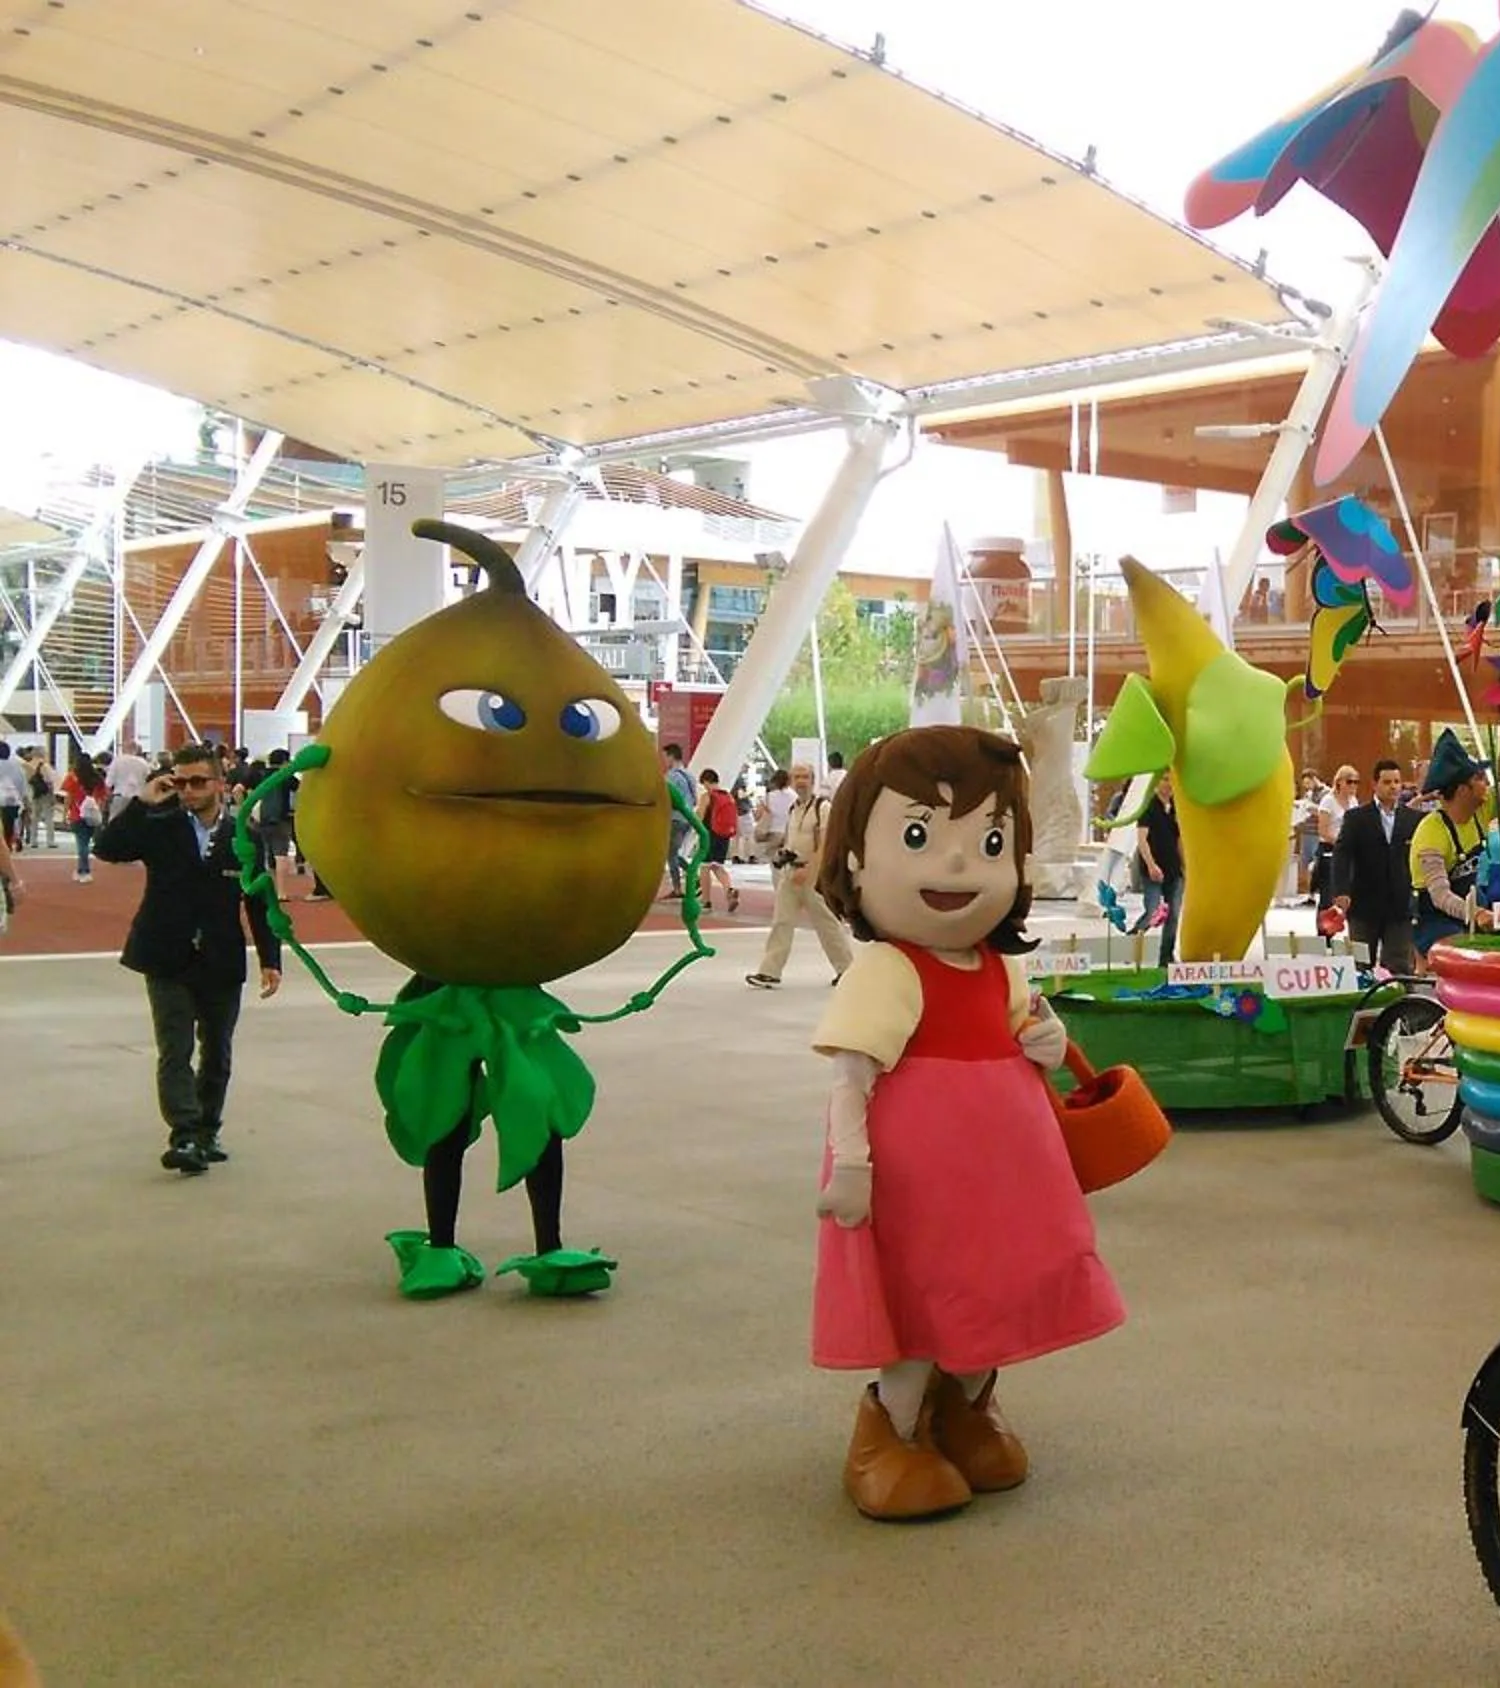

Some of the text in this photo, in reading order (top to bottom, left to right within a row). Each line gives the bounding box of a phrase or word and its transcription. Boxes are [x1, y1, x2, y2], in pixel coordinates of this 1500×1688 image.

[377, 481, 406, 506] 15
[1172, 965, 1264, 982] ARABELLA
[1276, 965, 1346, 992] GURY
